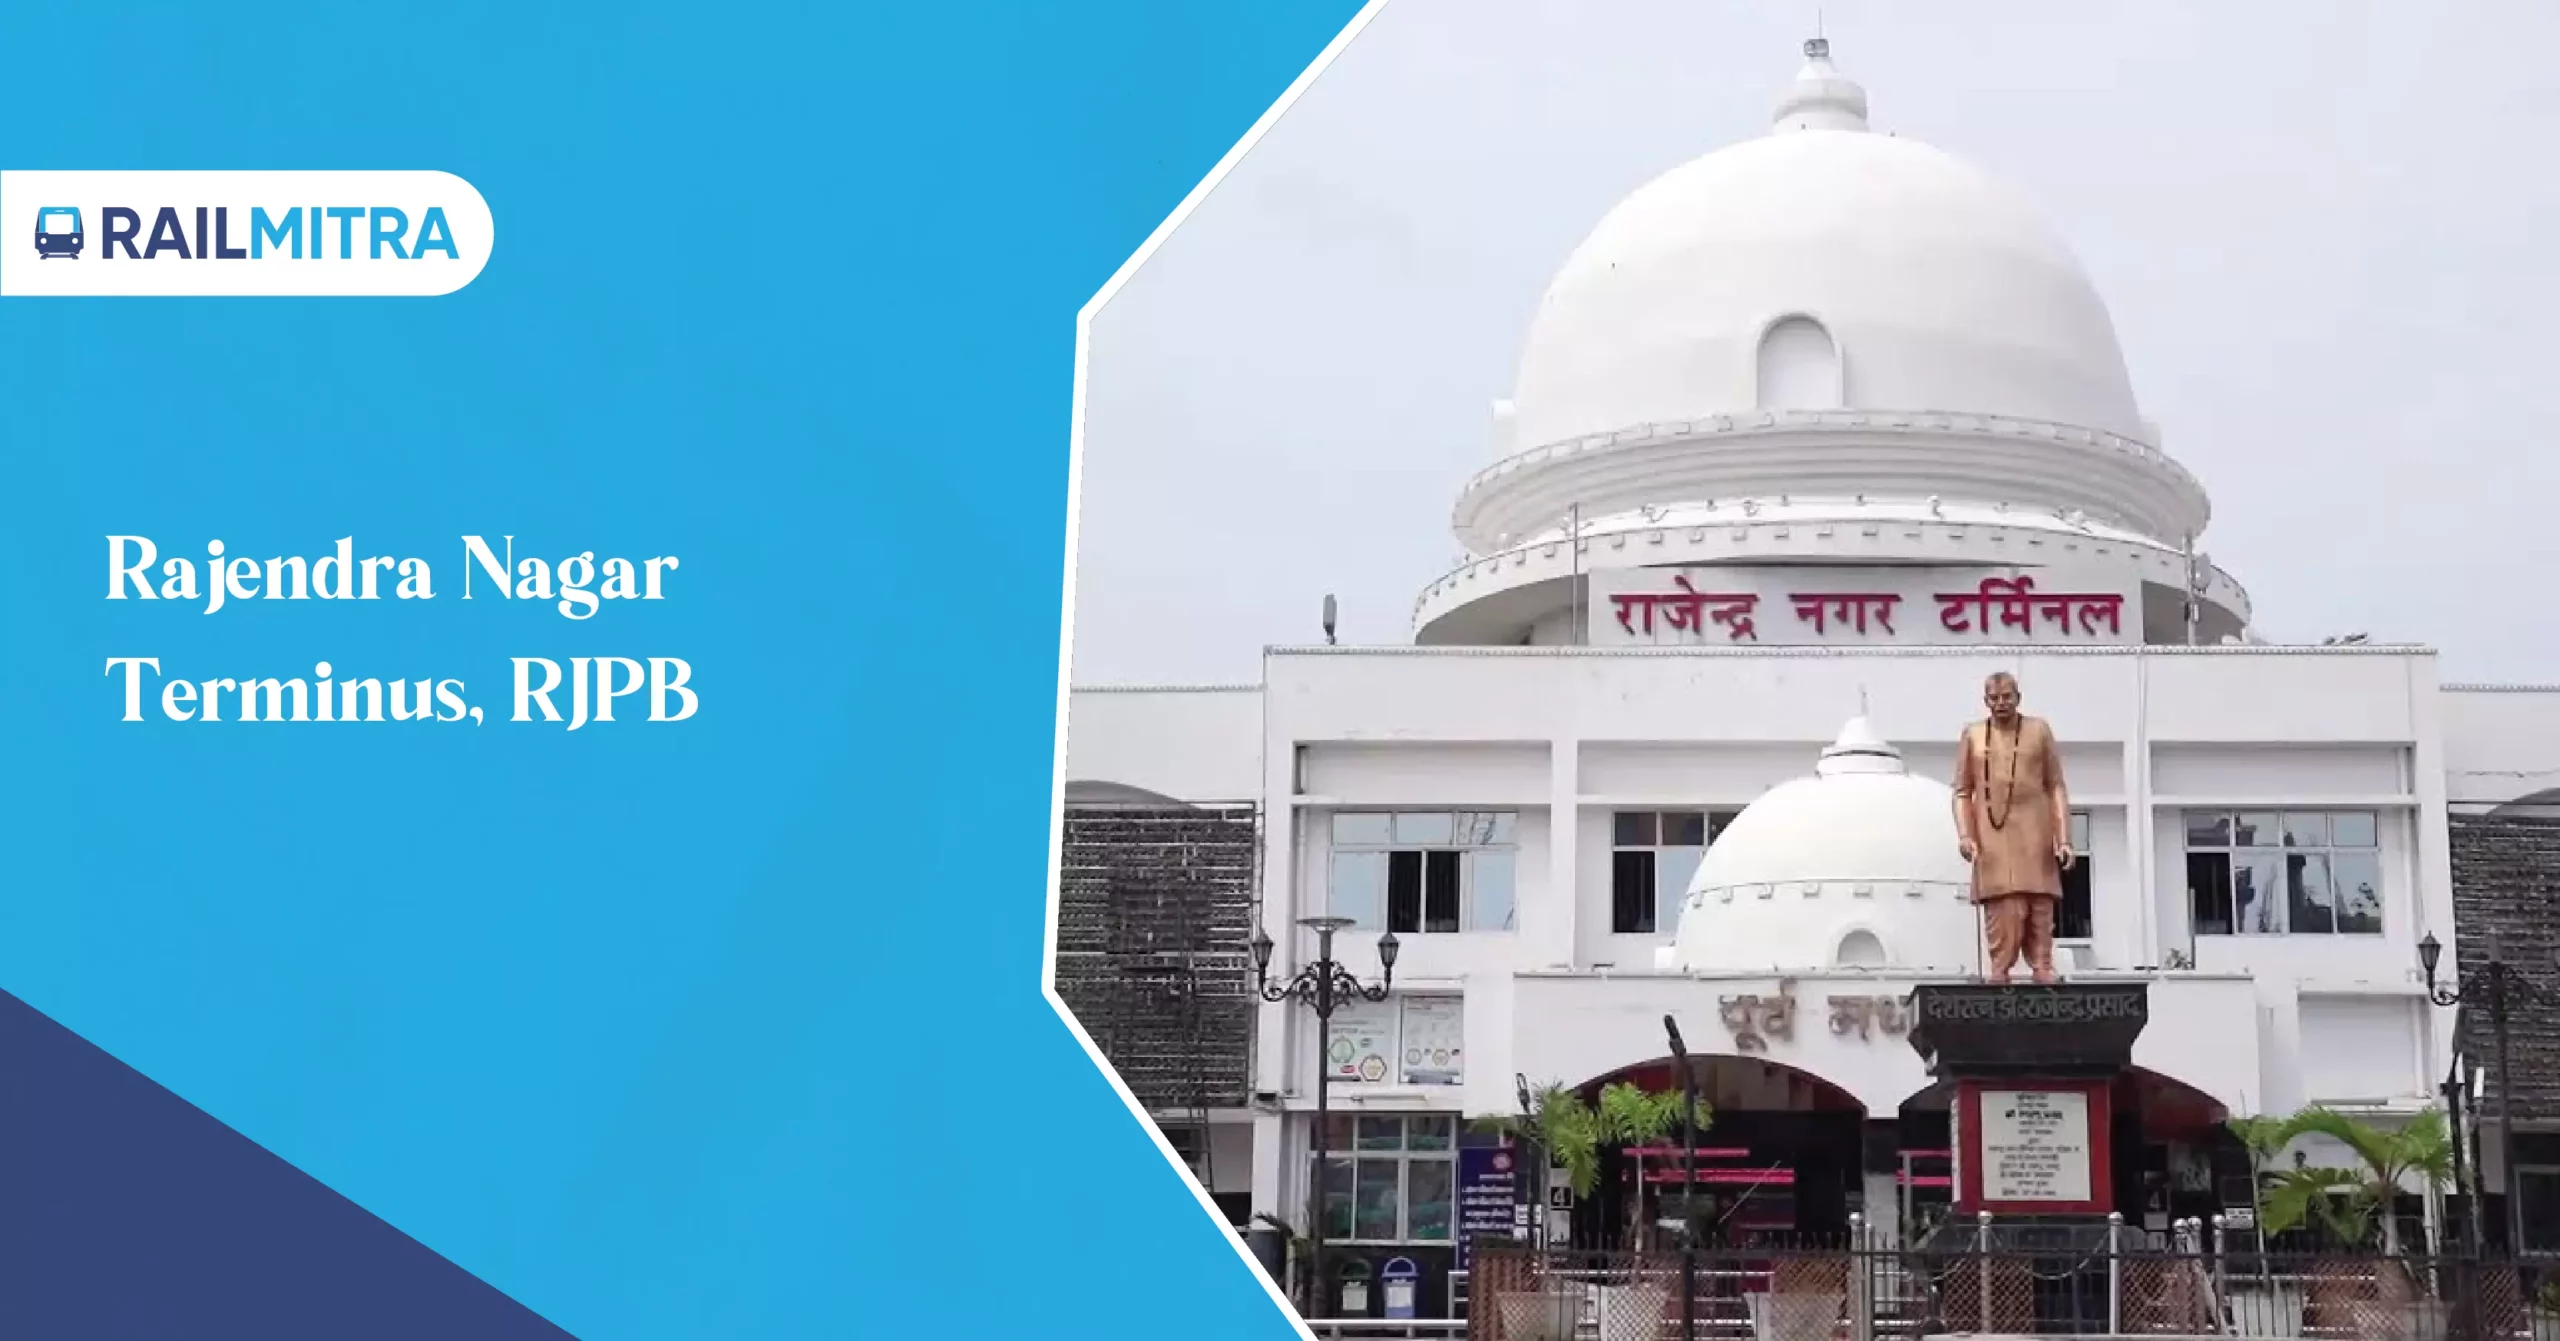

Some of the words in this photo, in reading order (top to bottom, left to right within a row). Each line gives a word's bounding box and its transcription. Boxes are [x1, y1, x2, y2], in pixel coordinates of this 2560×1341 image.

[1609, 575, 1758, 640] राजेन्द्र
[1789, 593, 1902, 636] नगर
[1934, 576, 2124, 636] टर्मिनल
[1718, 976, 1796, 1052] पूर्व
